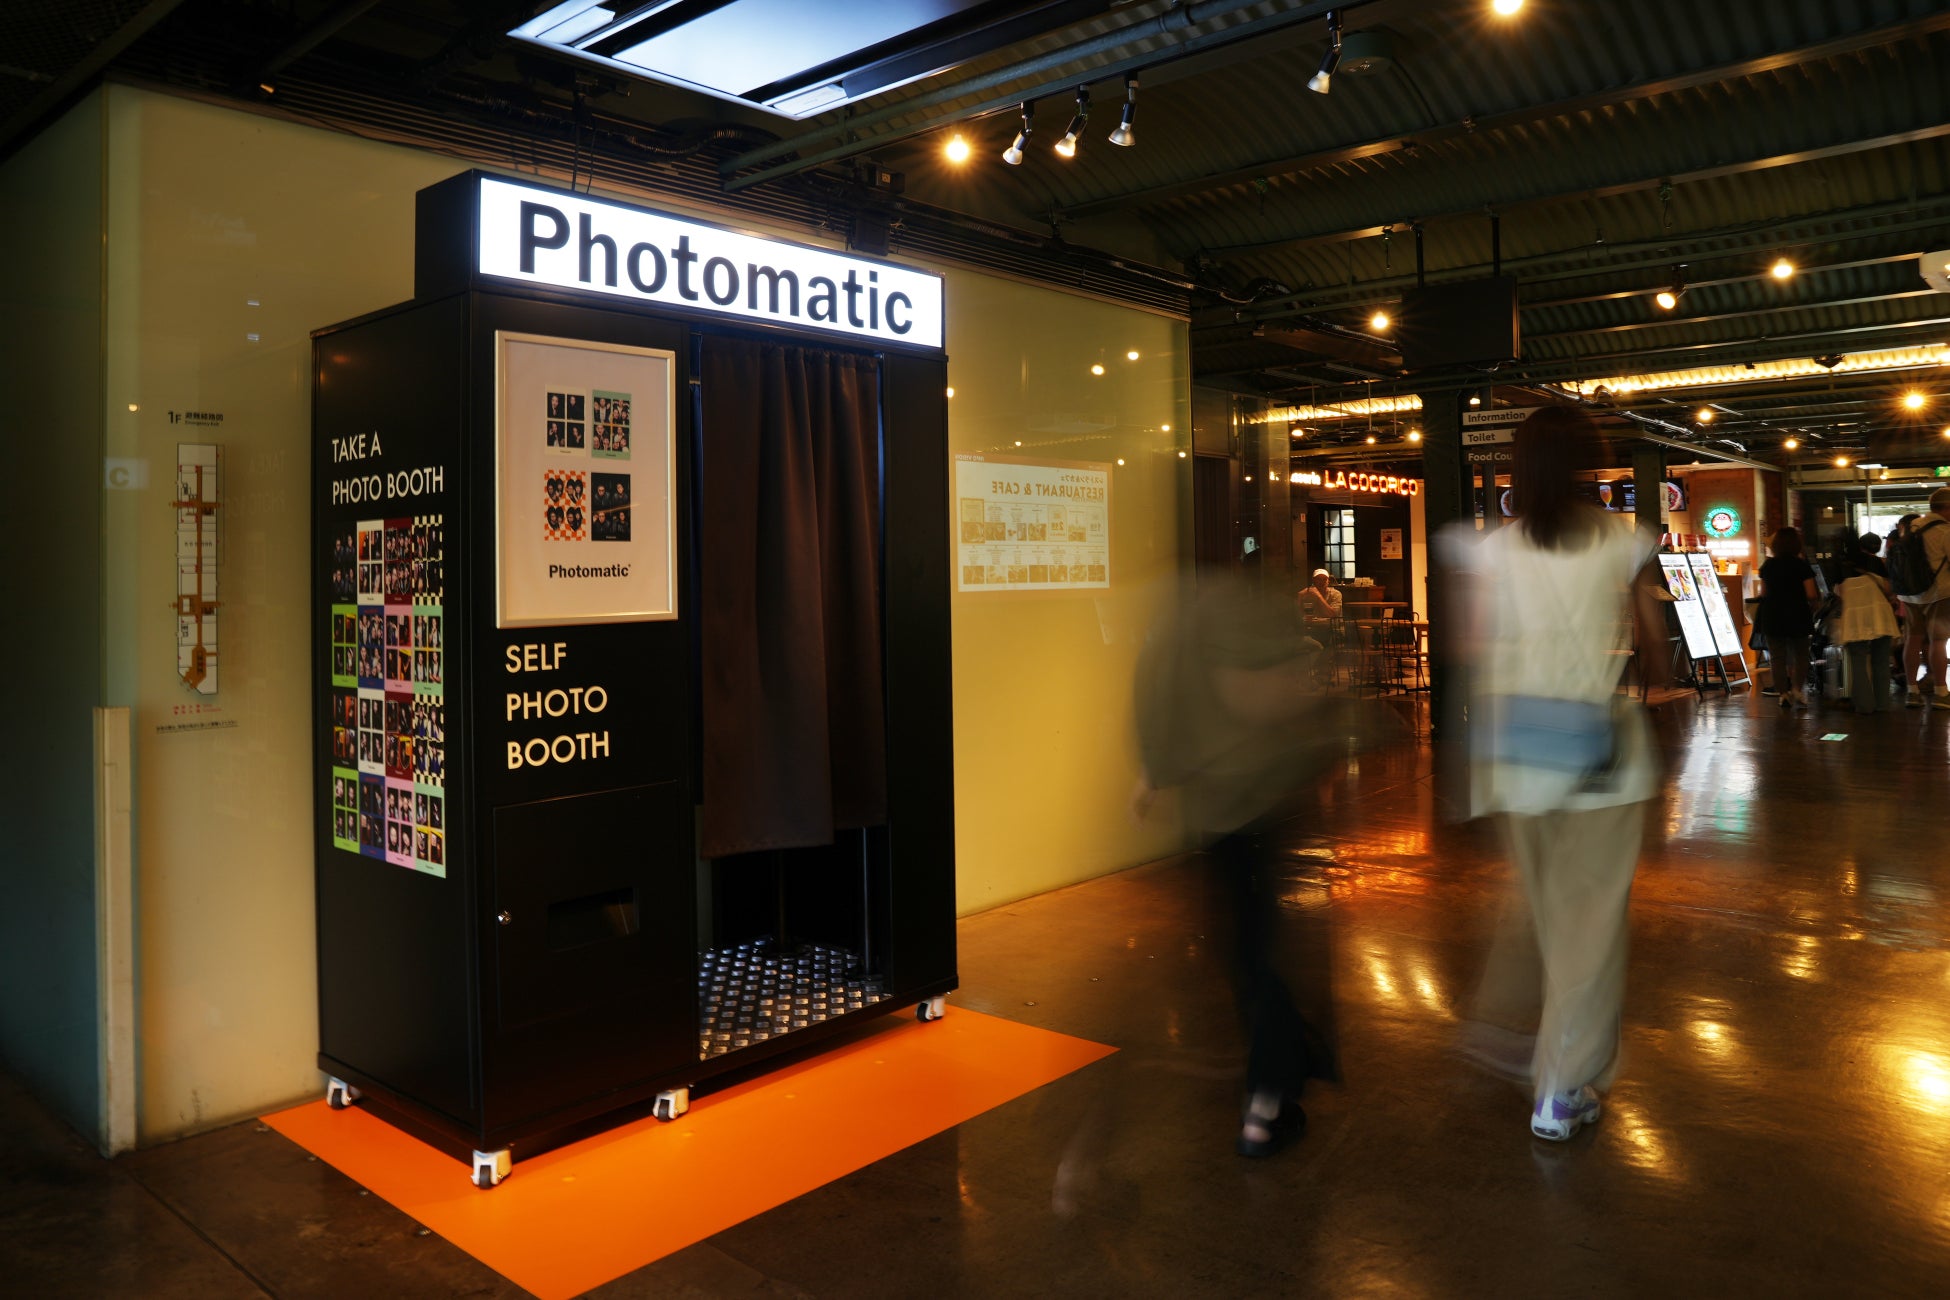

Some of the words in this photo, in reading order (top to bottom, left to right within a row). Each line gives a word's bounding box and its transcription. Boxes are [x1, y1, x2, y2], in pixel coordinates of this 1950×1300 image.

[520, 200, 913, 335] Photomatic
[168, 410, 182, 424] 1F
[1468, 411, 1526, 423] Information
[332, 434, 366, 463] TAKE
[370, 430, 382, 457] A
[1468, 433, 1496, 443] Toilet
[1468, 452, 1493, 462] Food
[1494, 452, 1513, 461] Cou
[333, 475, 382, 505] PHOTO
[387, 465, 444, 499] BOOTH
[1324, 469, 1348, 489] LA
[1349, 472, 1419, 496] COCORICO
[549, 564, 630, 578] Photomatic
[505, 642, 567, 673] SELF
[506, 685, 608, 721] PHOTO
[507, 730, 610, 770] BOOTH
